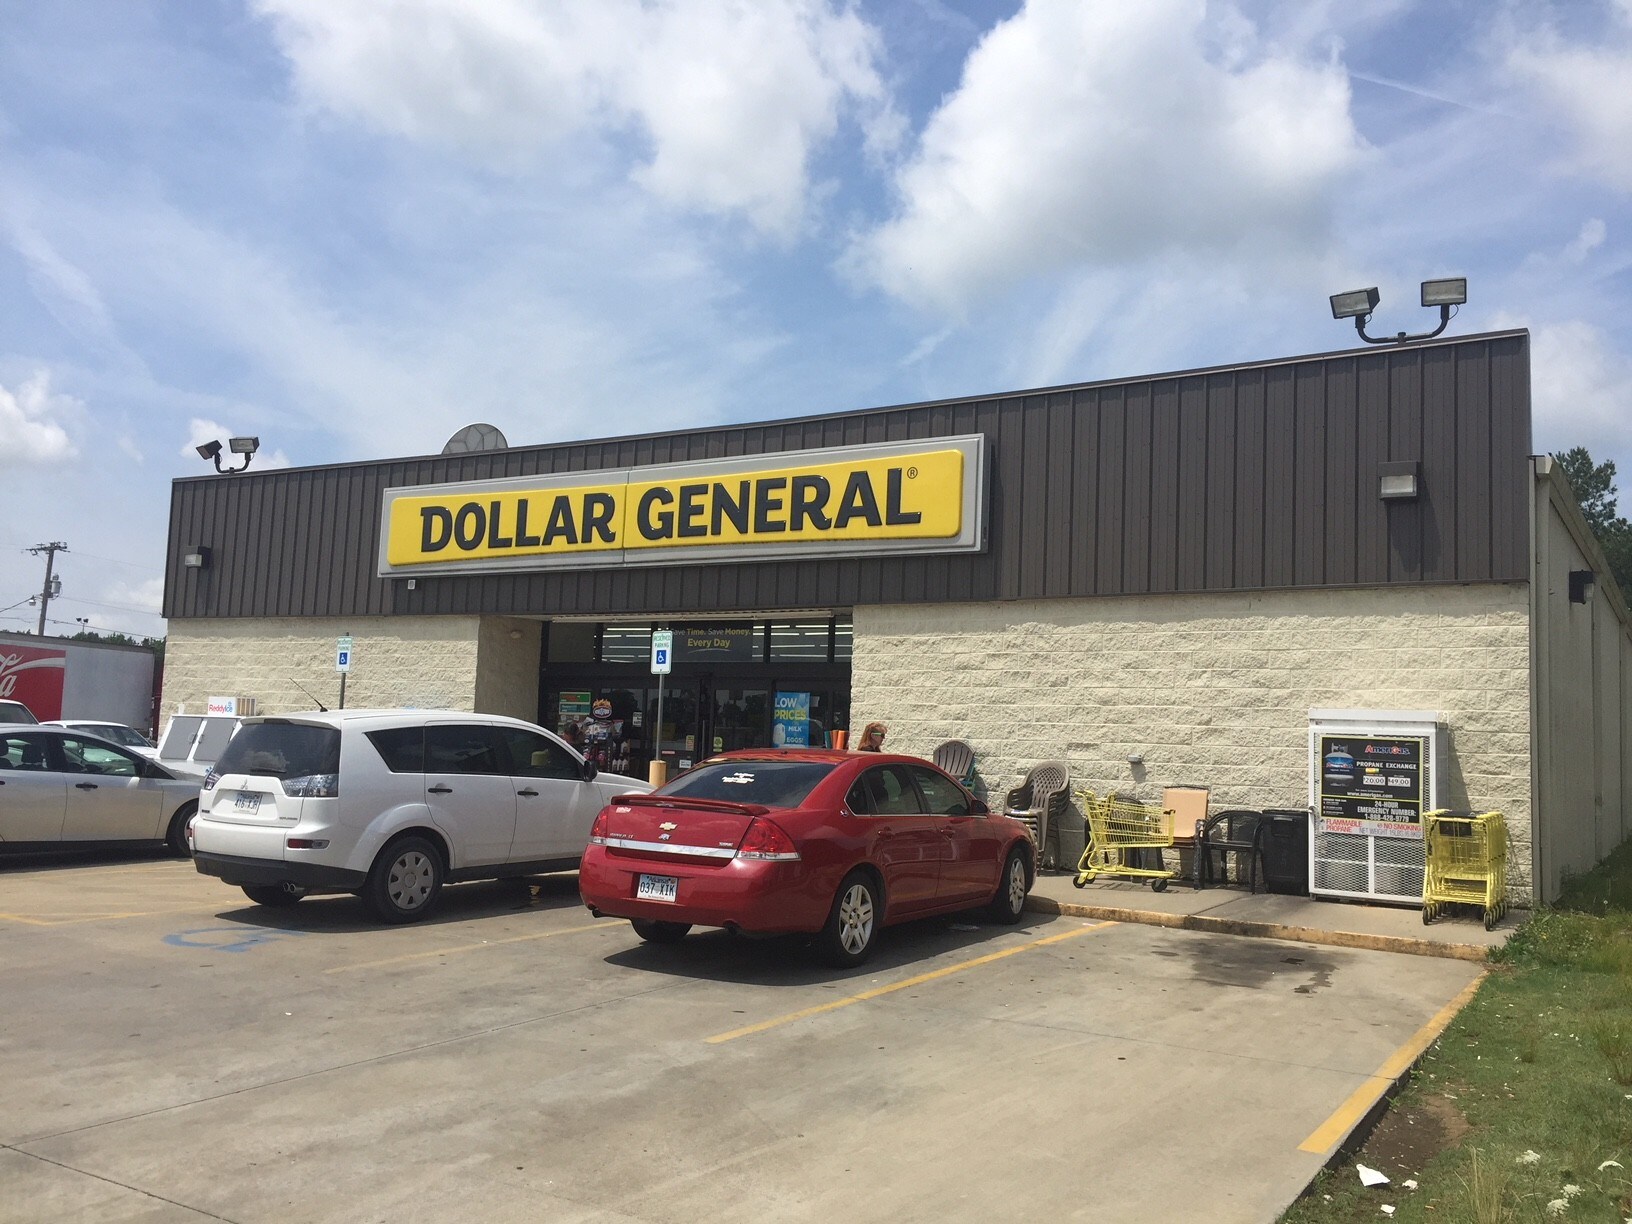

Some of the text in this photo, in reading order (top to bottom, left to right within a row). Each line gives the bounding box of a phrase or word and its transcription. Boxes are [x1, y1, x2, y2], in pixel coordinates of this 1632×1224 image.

[421, 467, 923, 552] DOLLAR GENERAL
[708, 628, 724, 636] Save
[725, 628, 751, 636] Money.
[687, 638, 731, 649] Every Day
[774, 697, 798, 708] LOW
[774, 709, 807, 720] PRICES
[1385, 762, 1417, 770] EXCHANGE
[1357, 806, 1417, 817] EMERGENCY NUMBER:
[1326, 819, 1363, 828] FLAMMABLE
[1393, 824, 1423, 832] SMOKING
[1326, 825, 1352, 833] PROPANE
[1370, 828, 1388, 836] WEIGHT
[640, 881, 656, 894] 037
